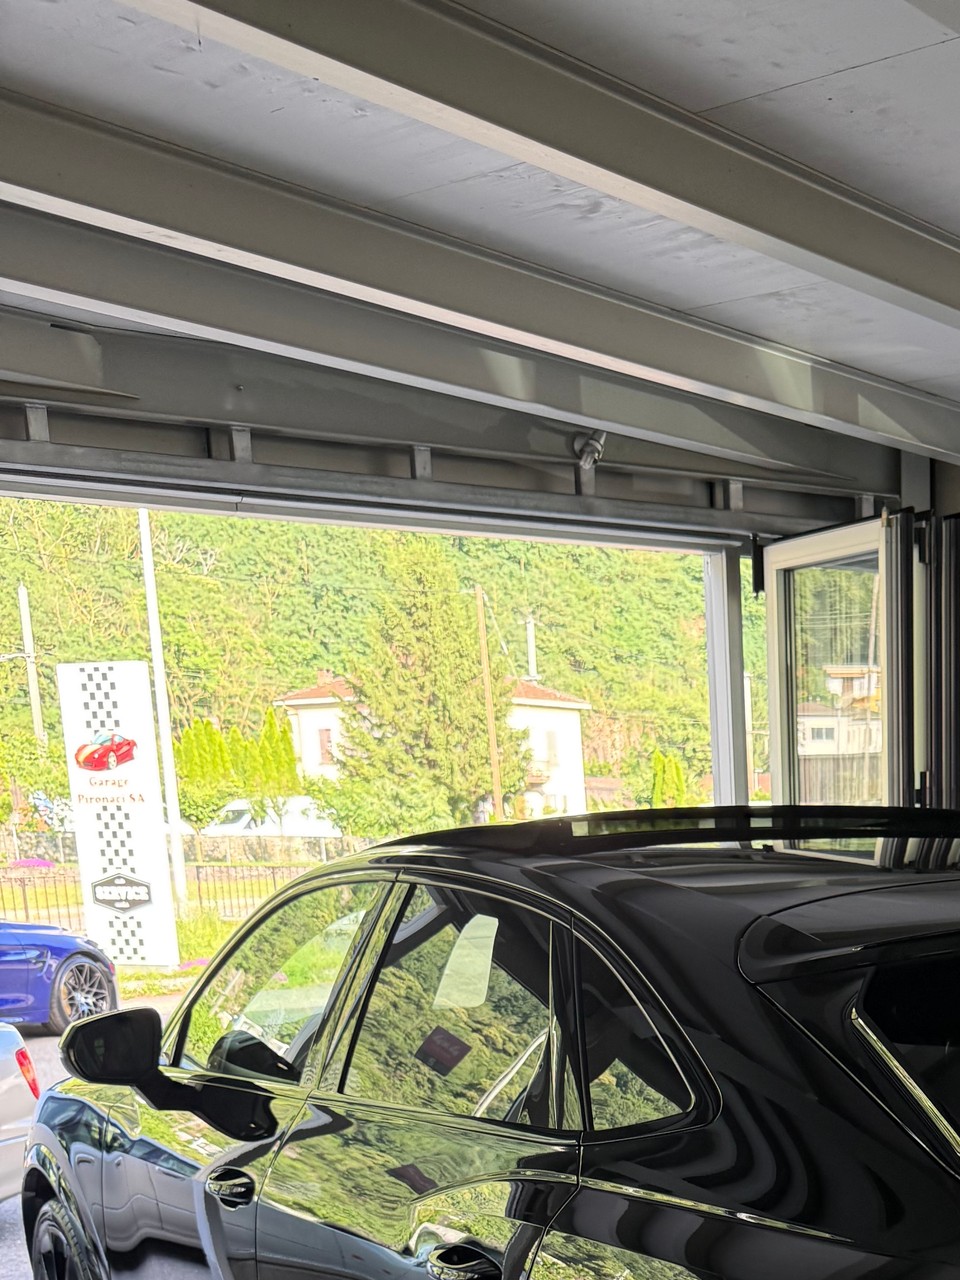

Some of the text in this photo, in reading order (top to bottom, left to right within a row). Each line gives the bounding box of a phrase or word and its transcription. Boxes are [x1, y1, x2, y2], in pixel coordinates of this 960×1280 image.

[89, 776, 129, 788] Garage
[129, 793, 145, 803] SA
[95, 885, 149, 901] SERVICE
